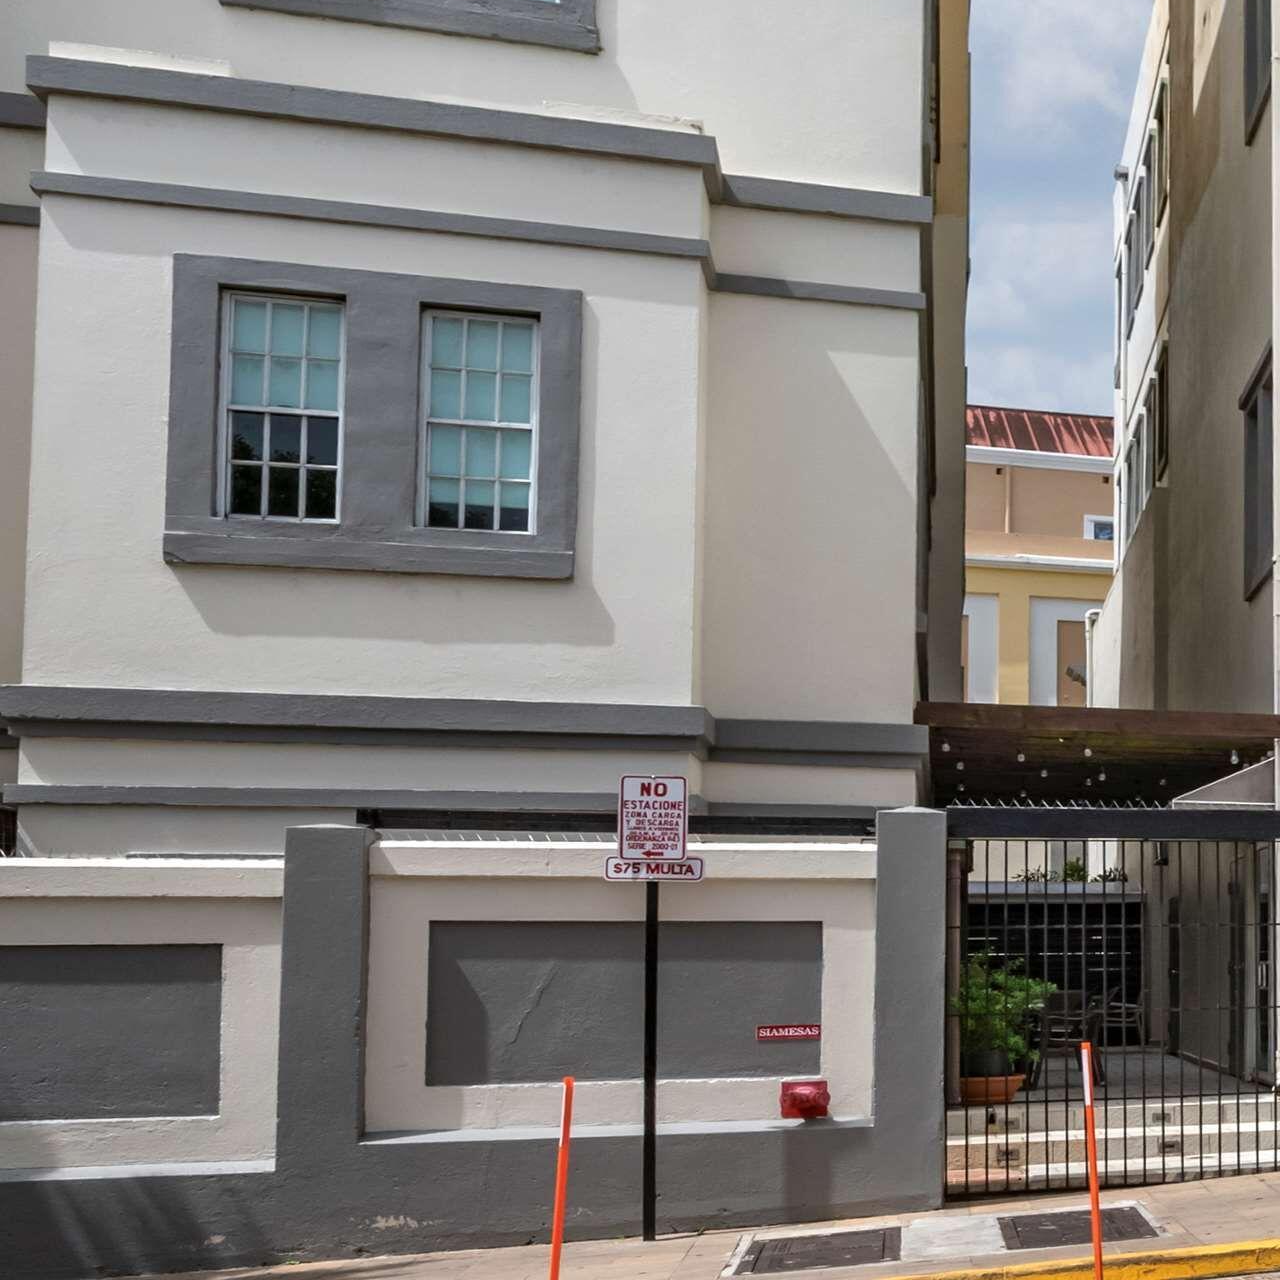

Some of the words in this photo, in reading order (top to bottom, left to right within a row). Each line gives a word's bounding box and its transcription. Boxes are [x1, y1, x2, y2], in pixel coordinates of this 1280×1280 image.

[640, 782, 667, 797] NO
[623, 800, 684, 811] ESTACIONE
[624, 811, 648, 819] ZONA
[635, 819, 680, 827] DESCARGA
[625, 834, 666, 842] ORDENANZA
[628, 842, 646, 850] SERIE
[613, 862, 641, 874] $75
[646, 863, 695, 875] MULTA
[759, 1026, 820, 1037] SIAMESAS
